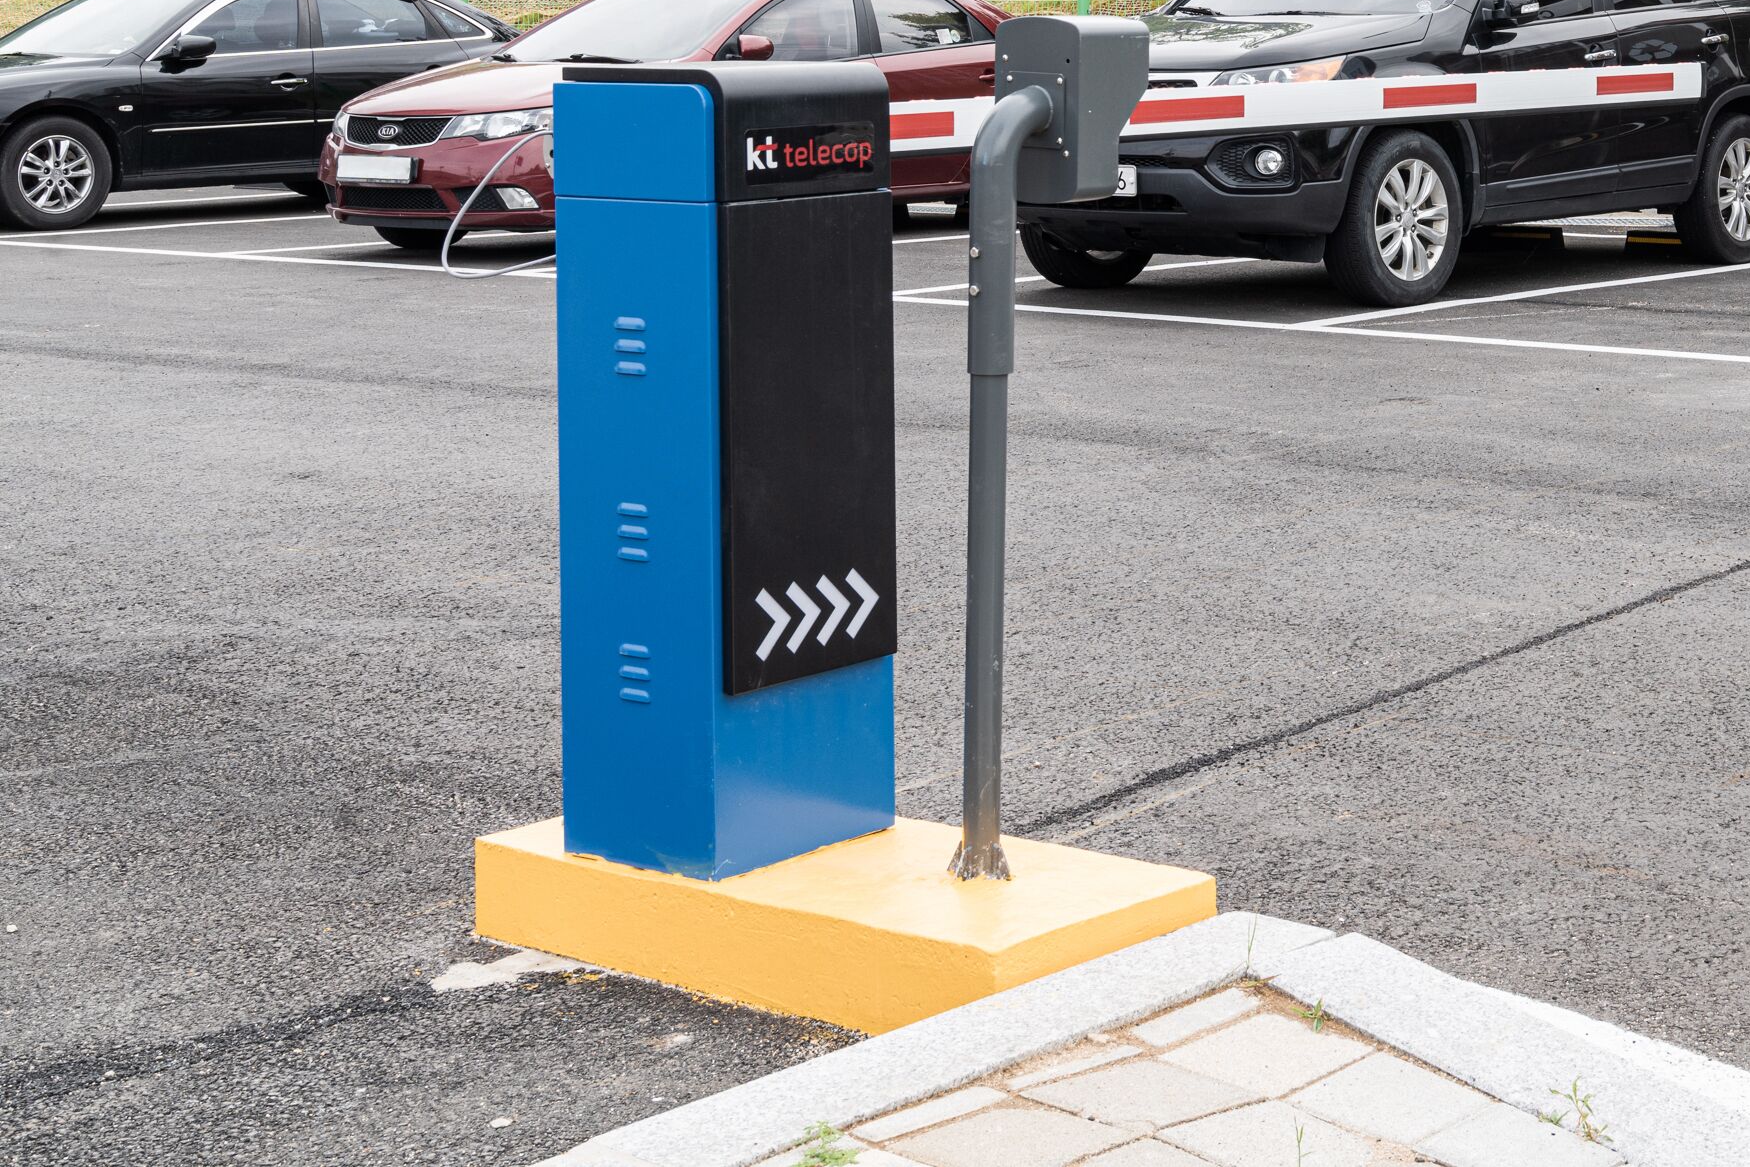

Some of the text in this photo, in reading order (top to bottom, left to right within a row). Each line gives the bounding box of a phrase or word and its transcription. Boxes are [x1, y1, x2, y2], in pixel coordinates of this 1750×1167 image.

[381, 127, 395, 136] KIA
[746, 136, 872, 171] kt telecop
